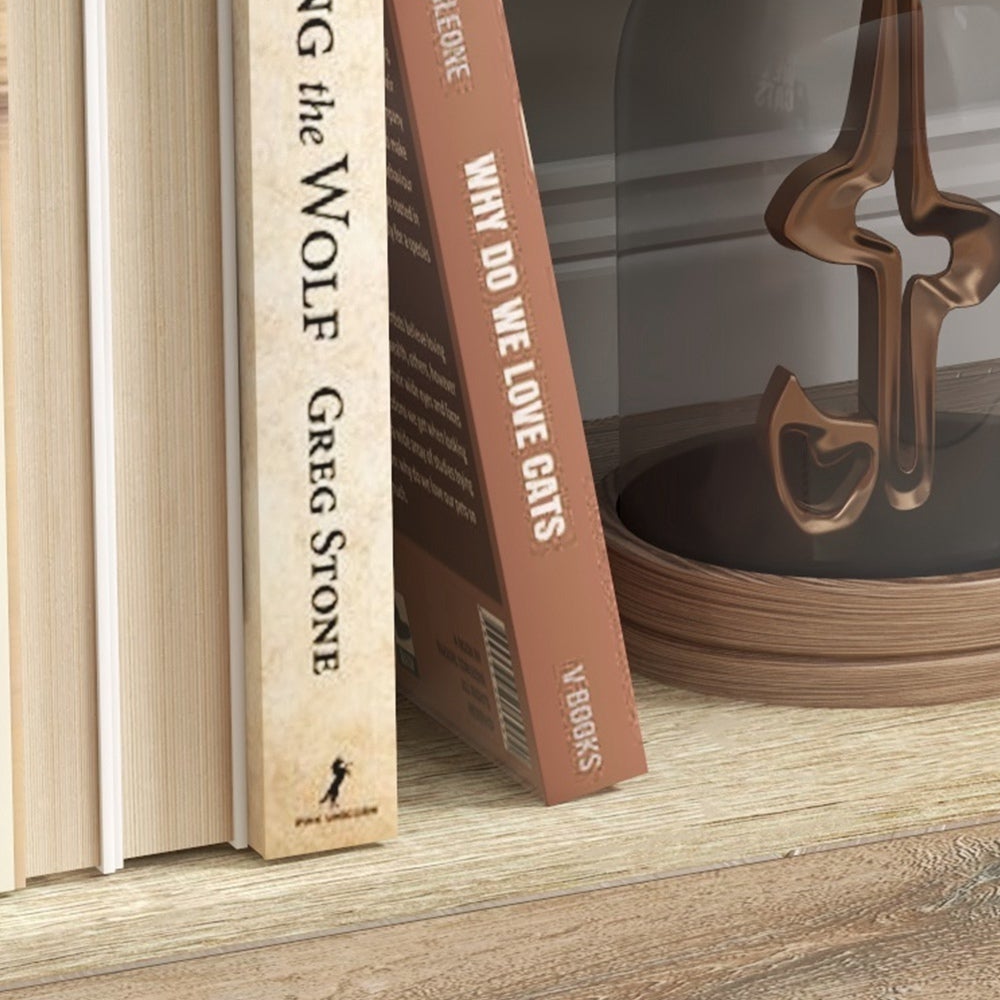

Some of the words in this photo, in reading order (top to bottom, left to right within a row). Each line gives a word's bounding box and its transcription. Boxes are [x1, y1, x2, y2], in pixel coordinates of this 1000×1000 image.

[299, 83, 335, 146] the
[464, 152, 507, 233] WHY
[300, 154, 350, 341] WOLF
[480, 239, 519, 293] DO
[491, 295, 532, 357] WE
[504, 360, 549, 450] LOVE
[308, 386, 344, 515] GREG
[522, 453, 566, 543] CATS
[310, 530, 346, 676] STONE
